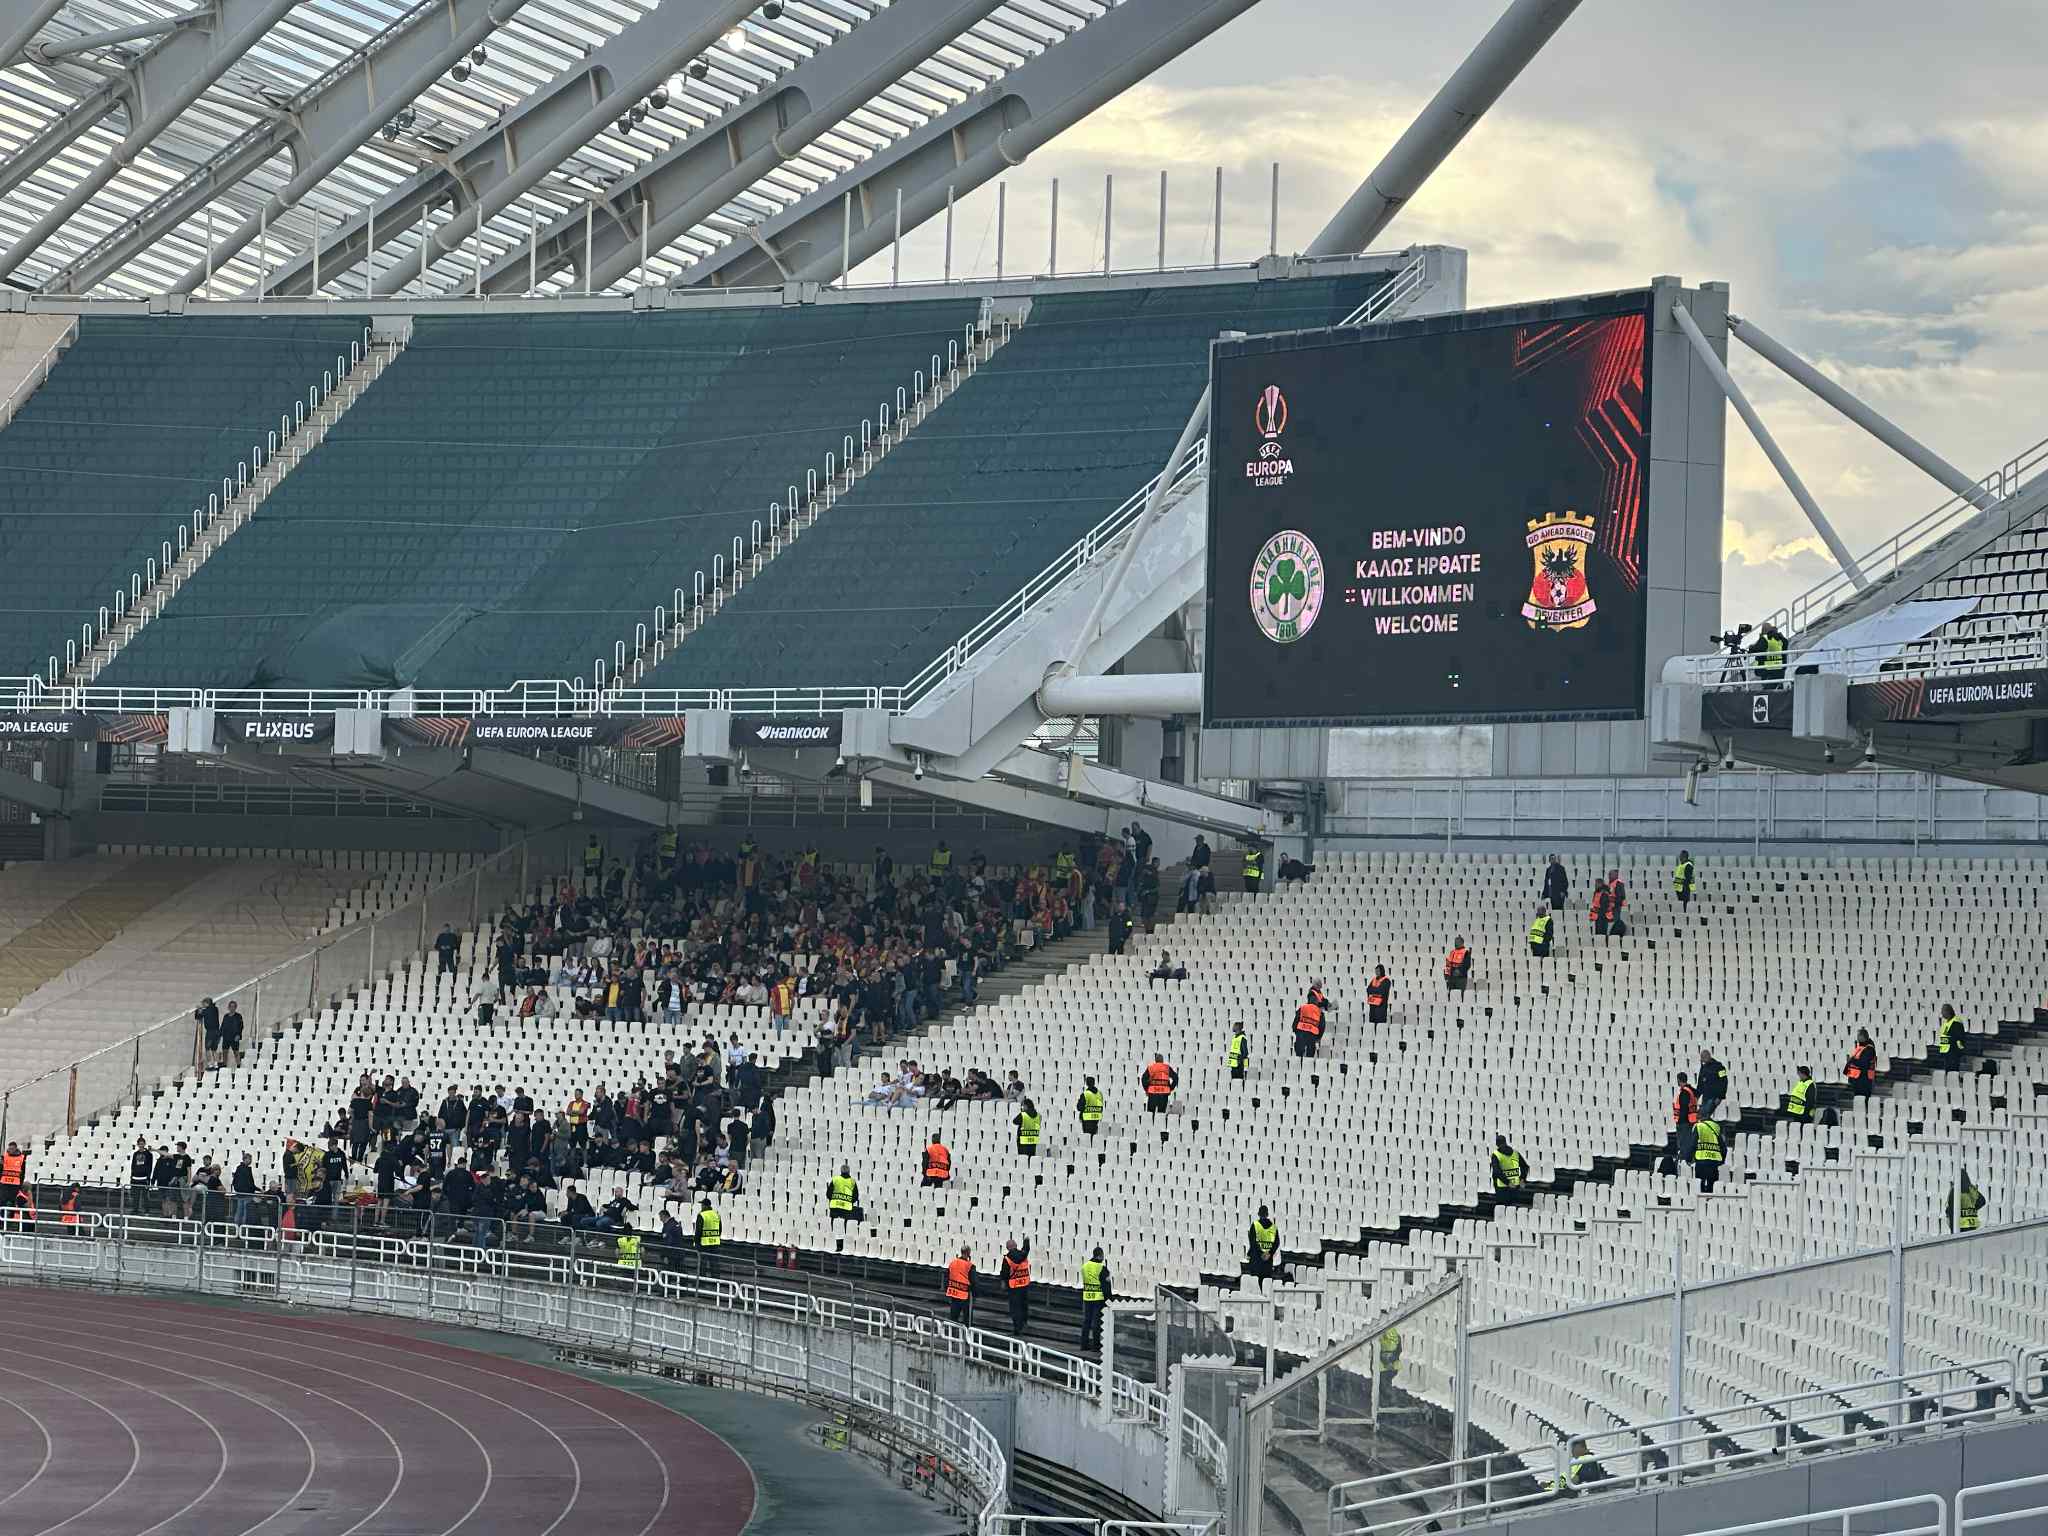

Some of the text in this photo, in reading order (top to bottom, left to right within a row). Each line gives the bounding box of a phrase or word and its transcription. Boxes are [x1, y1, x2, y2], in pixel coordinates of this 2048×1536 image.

[1260, 445, 1281, 457] UEFA
[1246, 459, 1294, 477] EUROPA
[1255, 476, 1284, 487] LEAGUE
[1372, 525, 1466, 550] BEM-VINDO
[1540, 528, 1565, 540] AHEAD
[1566, 527, 1594, 542] EAGLES
[1356, 553, 1481, 579] ΚΑΛΩΣ ΗΡΘΑΤΕ
[1360, 583, 1475, 607] WILLKOMMEN
[1374, 613, 1459, 635] WELCOME
[1929, 682, 2034, 704] UEFA EUROPA LEAGUE
[23, 722, 70, 733] LEAGUE
[476, 726, 593, 738] UEFA EUROPA LEAGUE
[430, 1139, 442, 1150] 57
